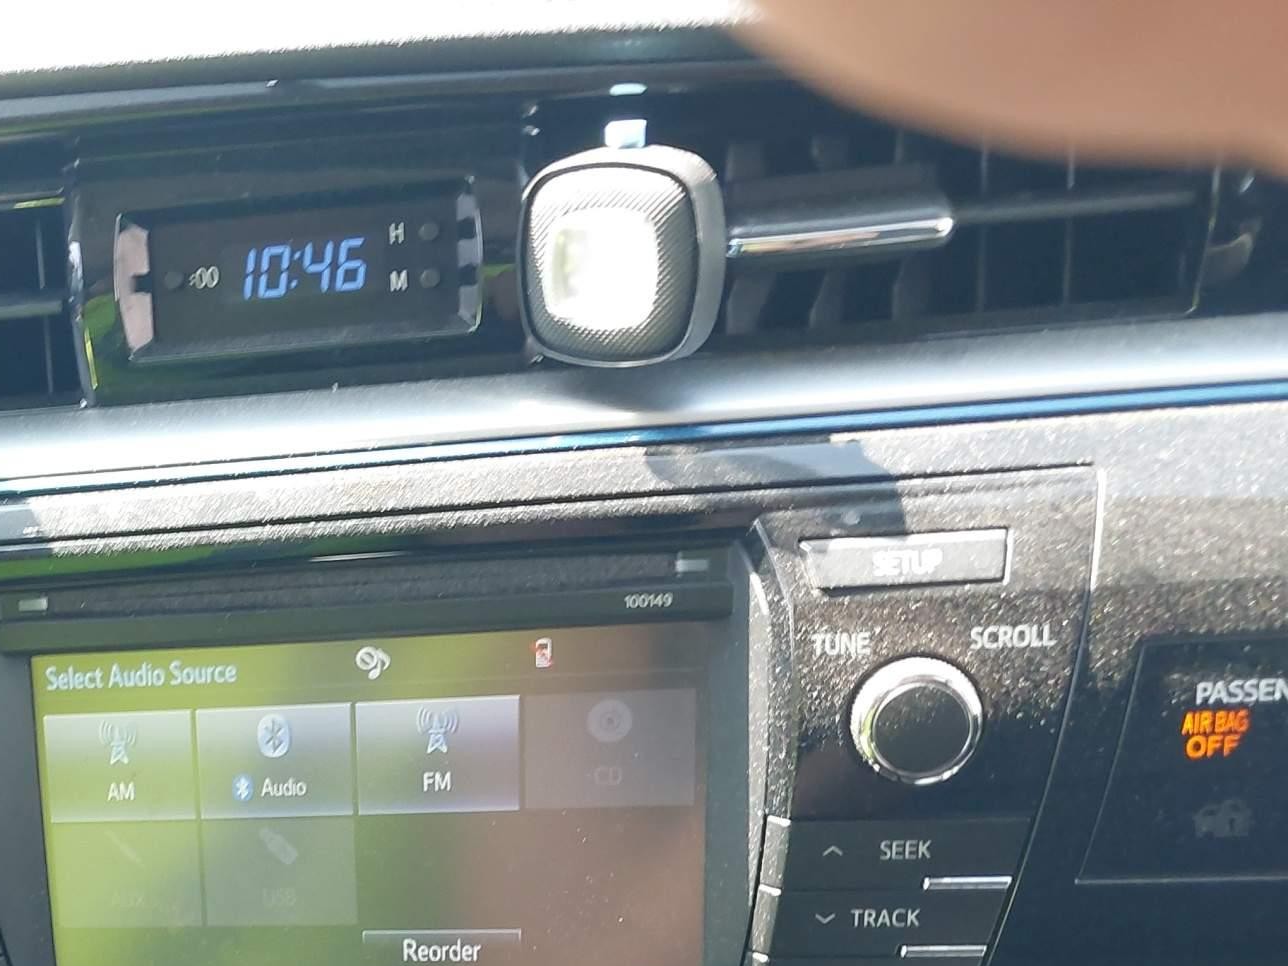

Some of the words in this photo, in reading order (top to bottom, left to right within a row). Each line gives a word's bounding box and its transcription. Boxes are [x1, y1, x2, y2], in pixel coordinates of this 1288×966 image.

[388, 221, 405, 245] H
[242, 237, 367, 300] 10:46
[389, 269, 408, 293] M
[872, 549, 943, 577] SETUP
[623, 591, 674, 609] 100149
[811, 630, 872, 656] TUNE
[969, 622, 1058, 650] SCROLL
[45, 665, 104, 690] Select
[108, 662, 165, 688] Audio
[168, 659, 238, 686] Source
[1185, 733, 1241, 759] OFF
[422, 771, 452, 792] FM
[593, 765, 623, 786] CD
[107, 781, 136, 802] AM
[261, 777, 307, 799] Audio
[879, 839, 933, 861] SEEK
[850, 907, 921, 928] TRACK
[402, 937, 482, 962] Reorder
